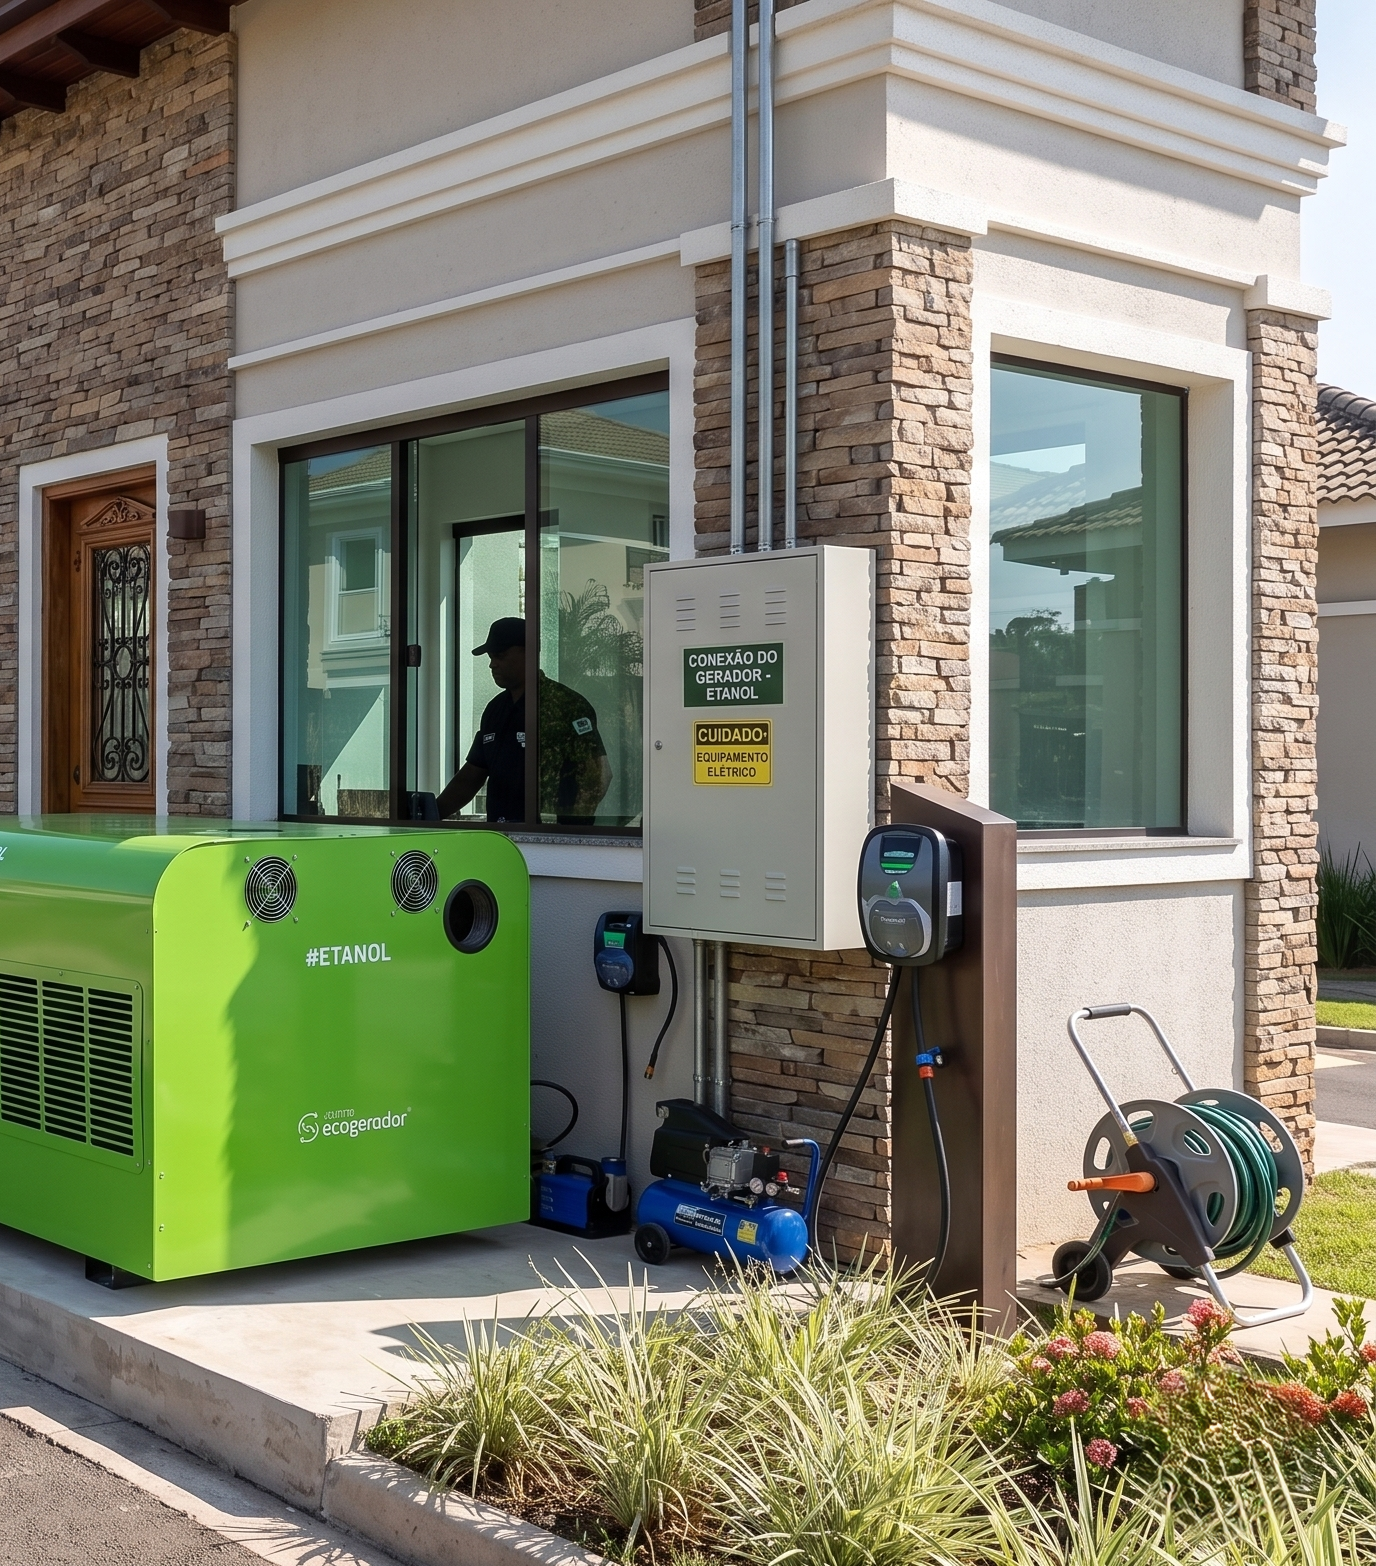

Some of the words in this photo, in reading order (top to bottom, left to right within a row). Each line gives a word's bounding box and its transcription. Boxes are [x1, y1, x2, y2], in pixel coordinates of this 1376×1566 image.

[688, 649, 754, 667] CONEXÃO
[757, 650, 778, 664] DO
[695, 668, 762, 684] GERADOR
[706, 686, 759, 701] ETANOL
[696, 752, 769, 763] EQUIPAMENTO
[707, 764, 757, 777] ELÉTRICO
[305, 943, 392, 967] #ETANOL
[322, 1110, 408, 1138] ecogerador
